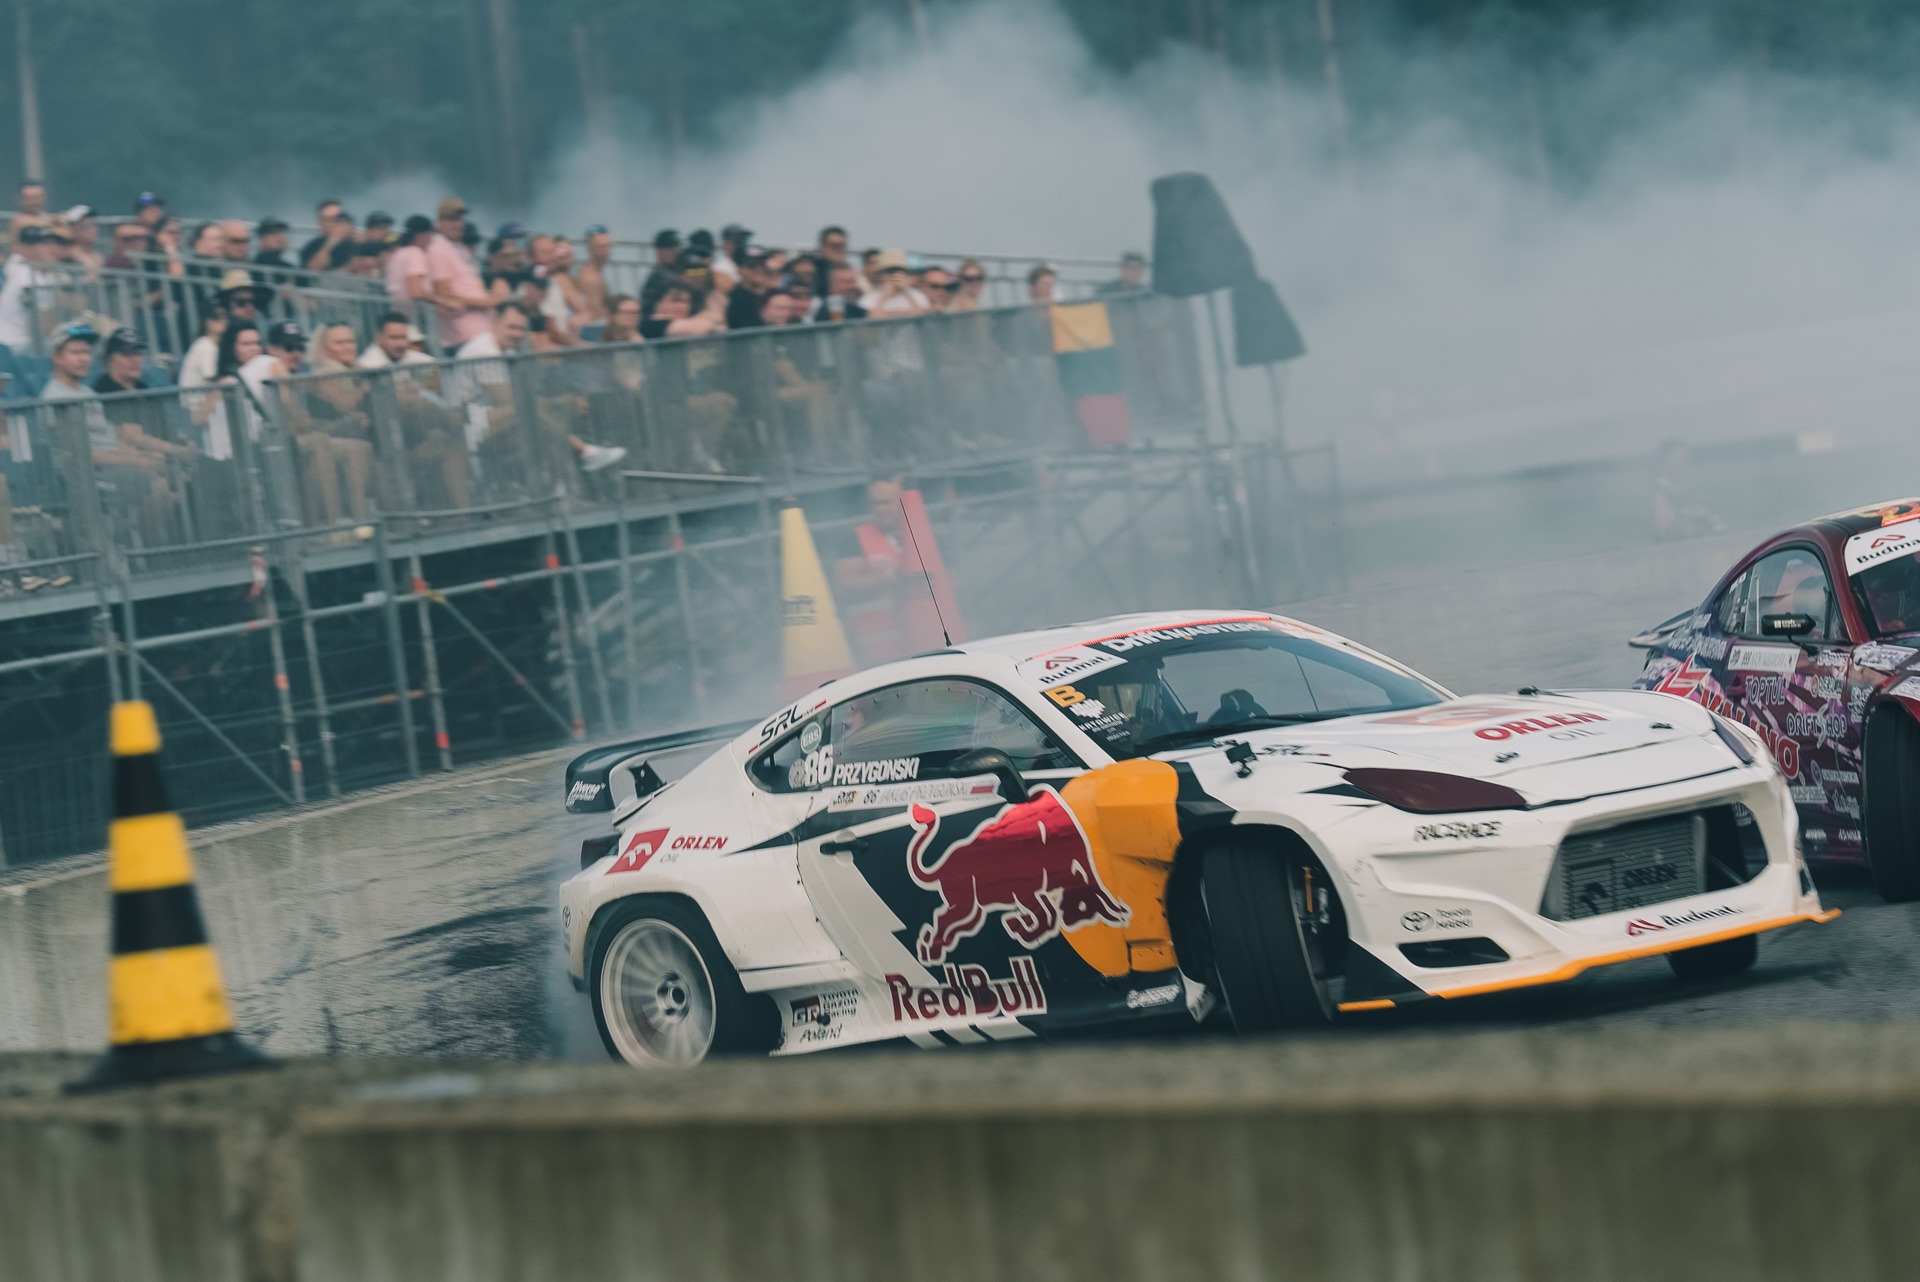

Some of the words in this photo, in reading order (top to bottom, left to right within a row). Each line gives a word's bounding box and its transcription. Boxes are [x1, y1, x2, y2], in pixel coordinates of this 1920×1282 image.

[1044, 685, 1086, 708] B
[1745, 675, 1786, 705] TOPTUL
[1474, 711, 1609, 741] ORLEN
[804, 745, 834, 786] 86
[833, 757, 920, 786] PRZYGONSKI
[671, 835, 729, 850] ORLEN
[885, 964, 966, 1021] Red
[962, 957, 1045, 1017] Bull
